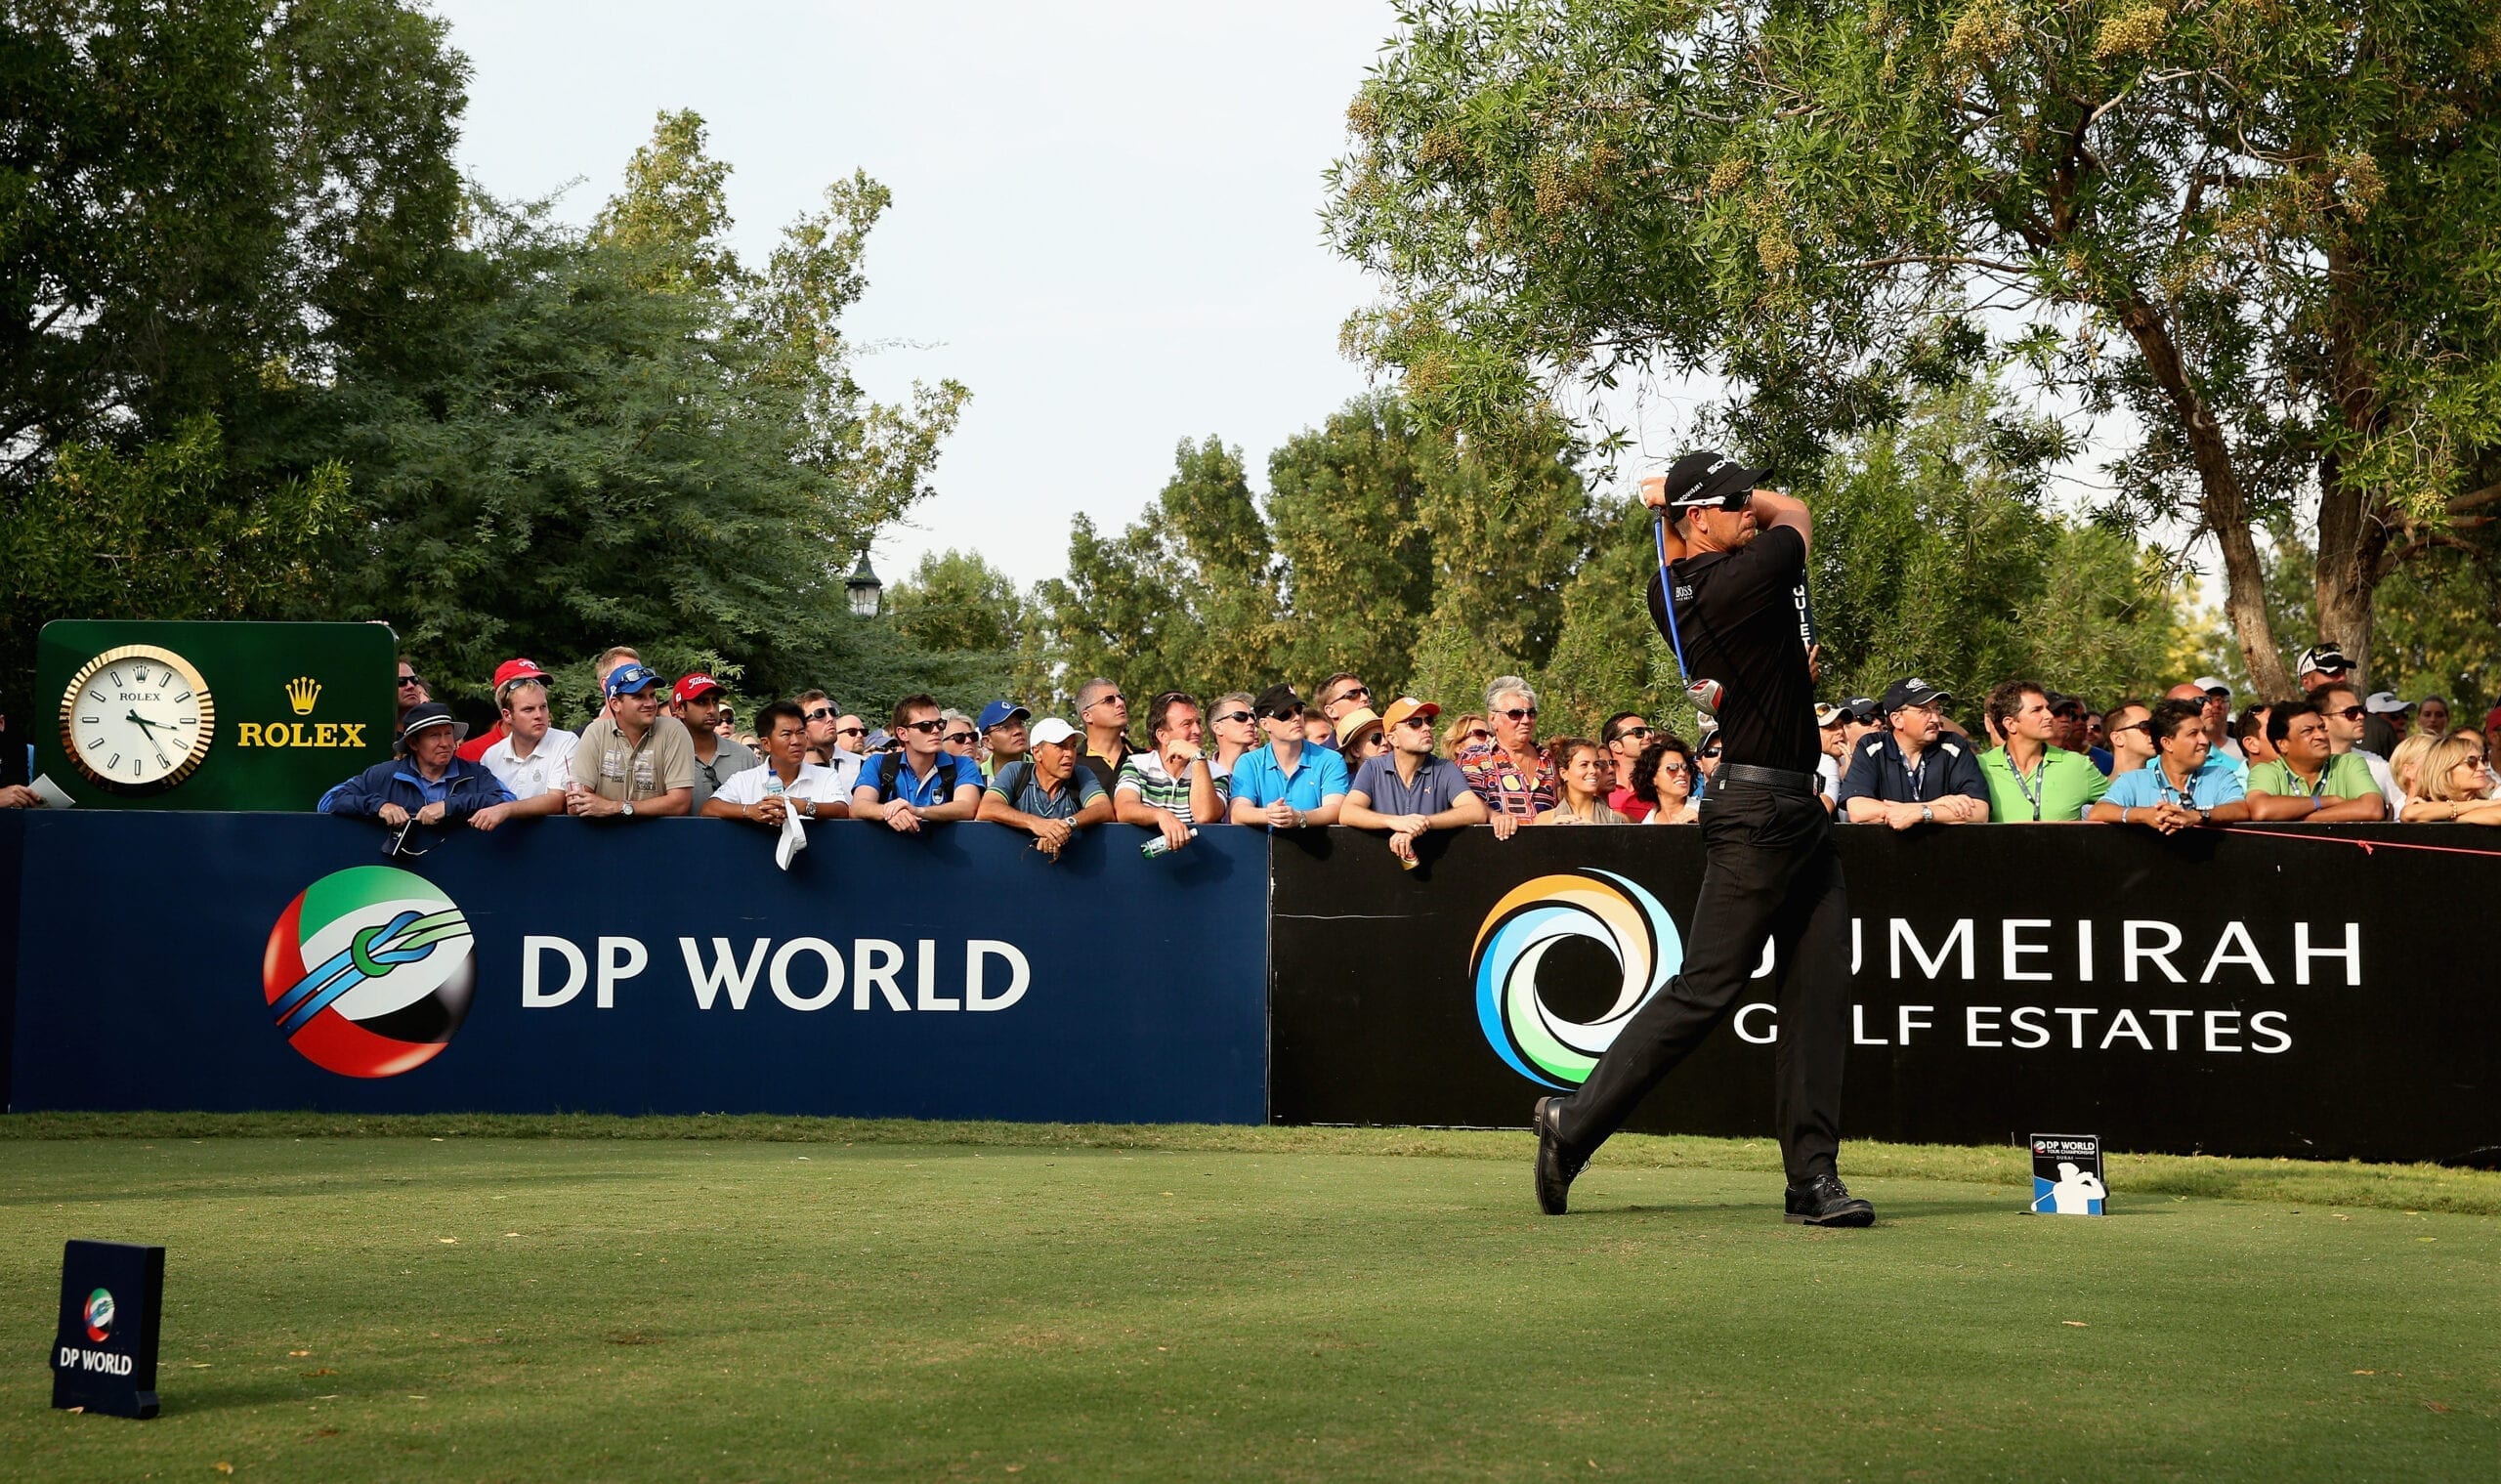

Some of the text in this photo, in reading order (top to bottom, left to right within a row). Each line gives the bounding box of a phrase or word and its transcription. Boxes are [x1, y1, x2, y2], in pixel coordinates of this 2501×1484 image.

[1675, 585, 1693, 597] BOSS
[1793, 584, 1811, 647] QUIET
[119, 692, 161, 701] ROLEX
[237, 723, 366, 747] ROLEX
[523, 936, 1031, 1012] DP WORLD
[1734, 1003, 2292, 1054] GLF ESTATES
[2047, 1141, 2096, 1151] DP WORLD
[60, 1347, 133, 1377] DP WORLD
